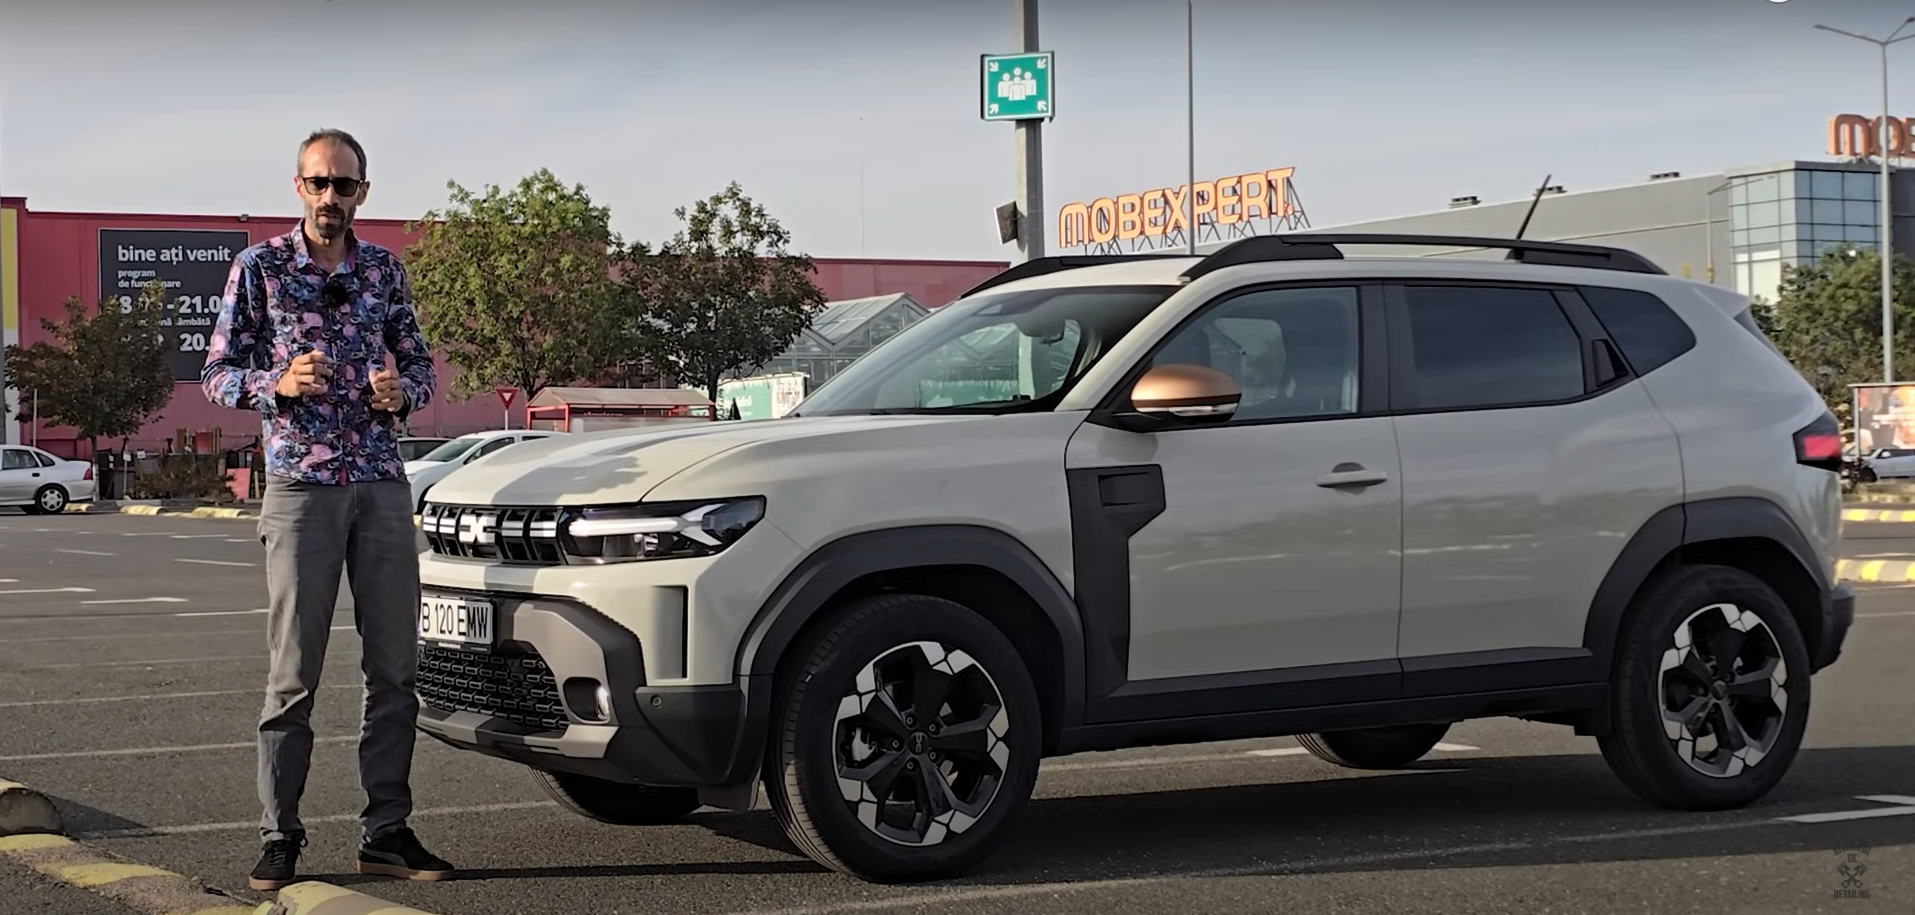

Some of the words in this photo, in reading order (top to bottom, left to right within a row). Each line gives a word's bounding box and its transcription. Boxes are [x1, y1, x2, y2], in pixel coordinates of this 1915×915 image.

[117, 245, 156, 262] bine
[187, 245, 231, 262] venit
[117, 269, 156, 279] program
[118, 279, 129, 288] de
[178, 295, 222, 314] 21.0
[422, 602, 431, 633] B
[435, 603, 454, 635] 120
[457, 605, 488, 638] EMW
